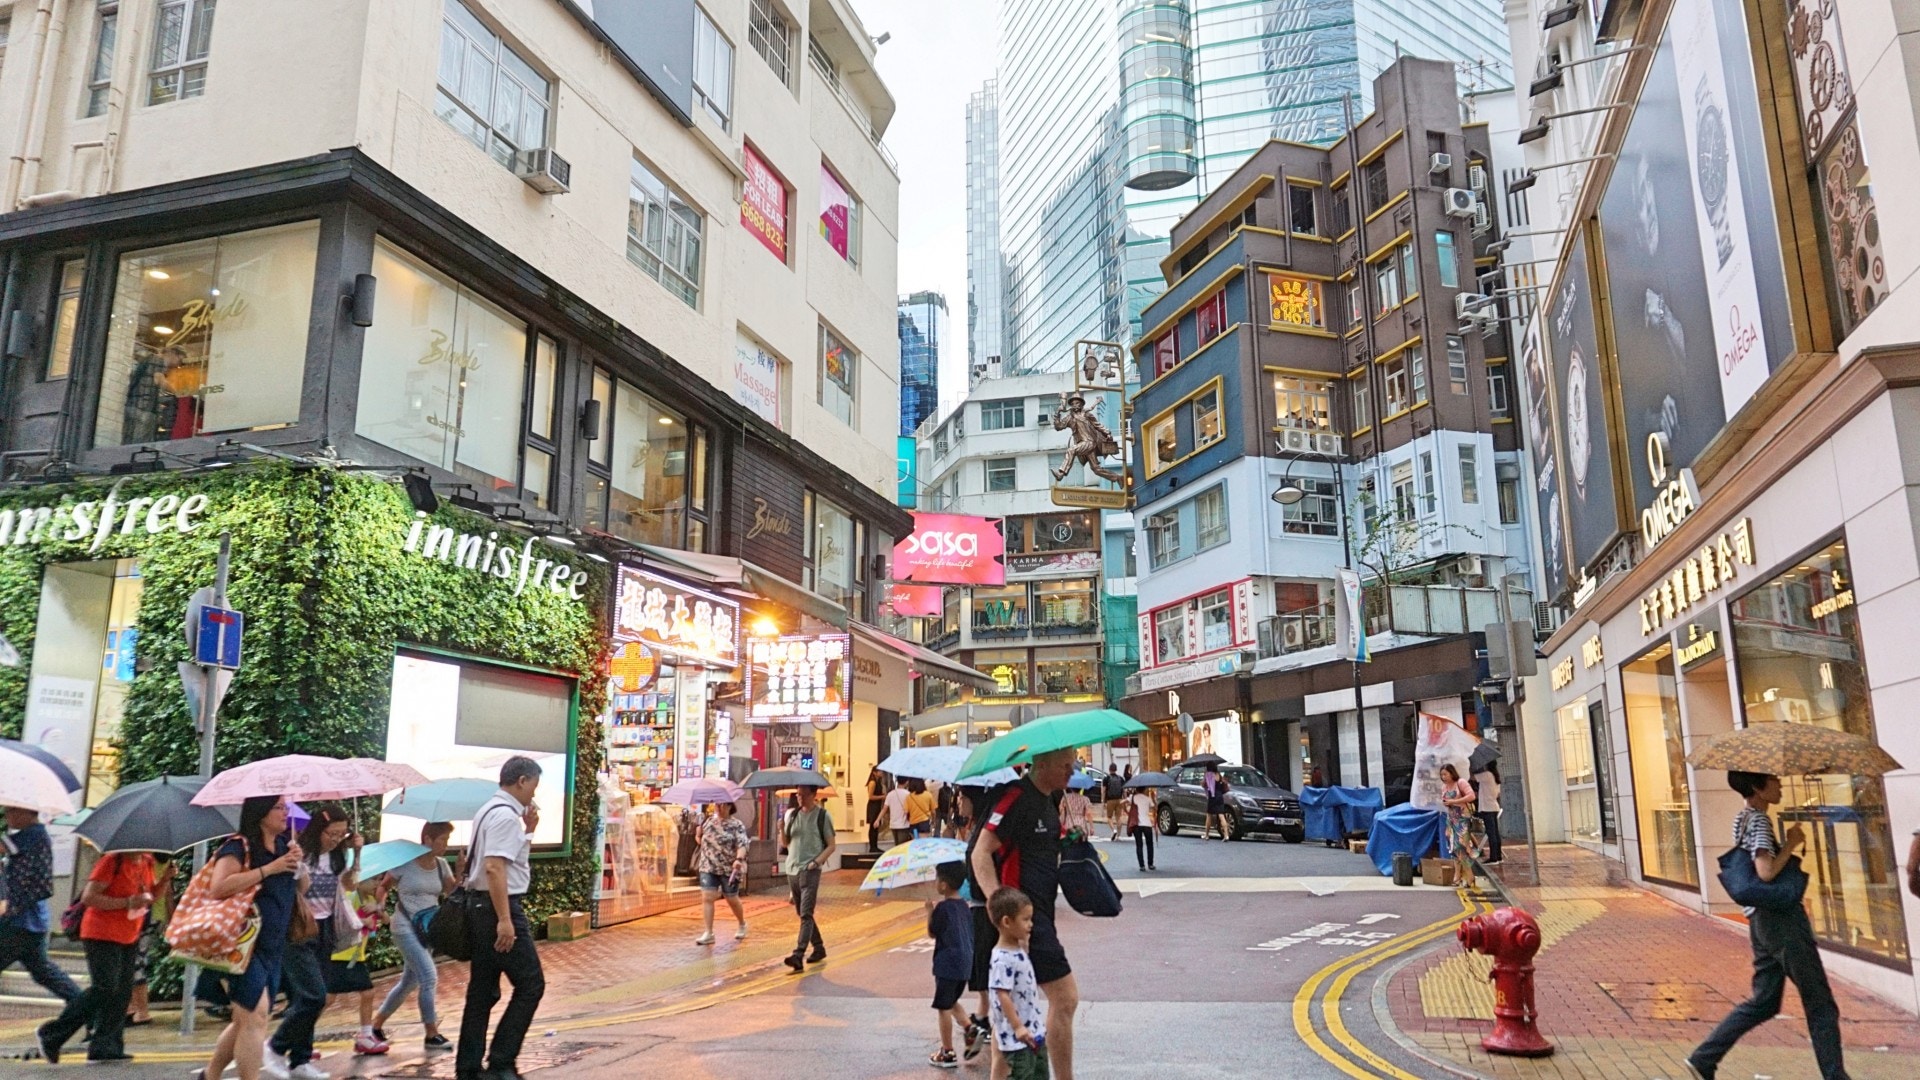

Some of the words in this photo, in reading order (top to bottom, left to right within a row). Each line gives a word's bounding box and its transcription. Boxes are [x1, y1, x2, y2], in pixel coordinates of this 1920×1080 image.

[743, 180, 761, 209] FOR
[754, 164, 778, 206] 招租
[1723, 322, 1758, 377] OMEGA
[735, 362, 776, 407] Massage
[746, 497, 792, 539] Blonde
[1642, 468, 1694, 548] OMEGA
[403, 510, 588, 600] innisfree
[905, 530, 978, 557] sasa
[932, 557, 944, 569] life
[945, 559, 974, 571] beautiful
[1013, 556, 1044, 564] KARMA
[801, 758, 813, 769] 2F
